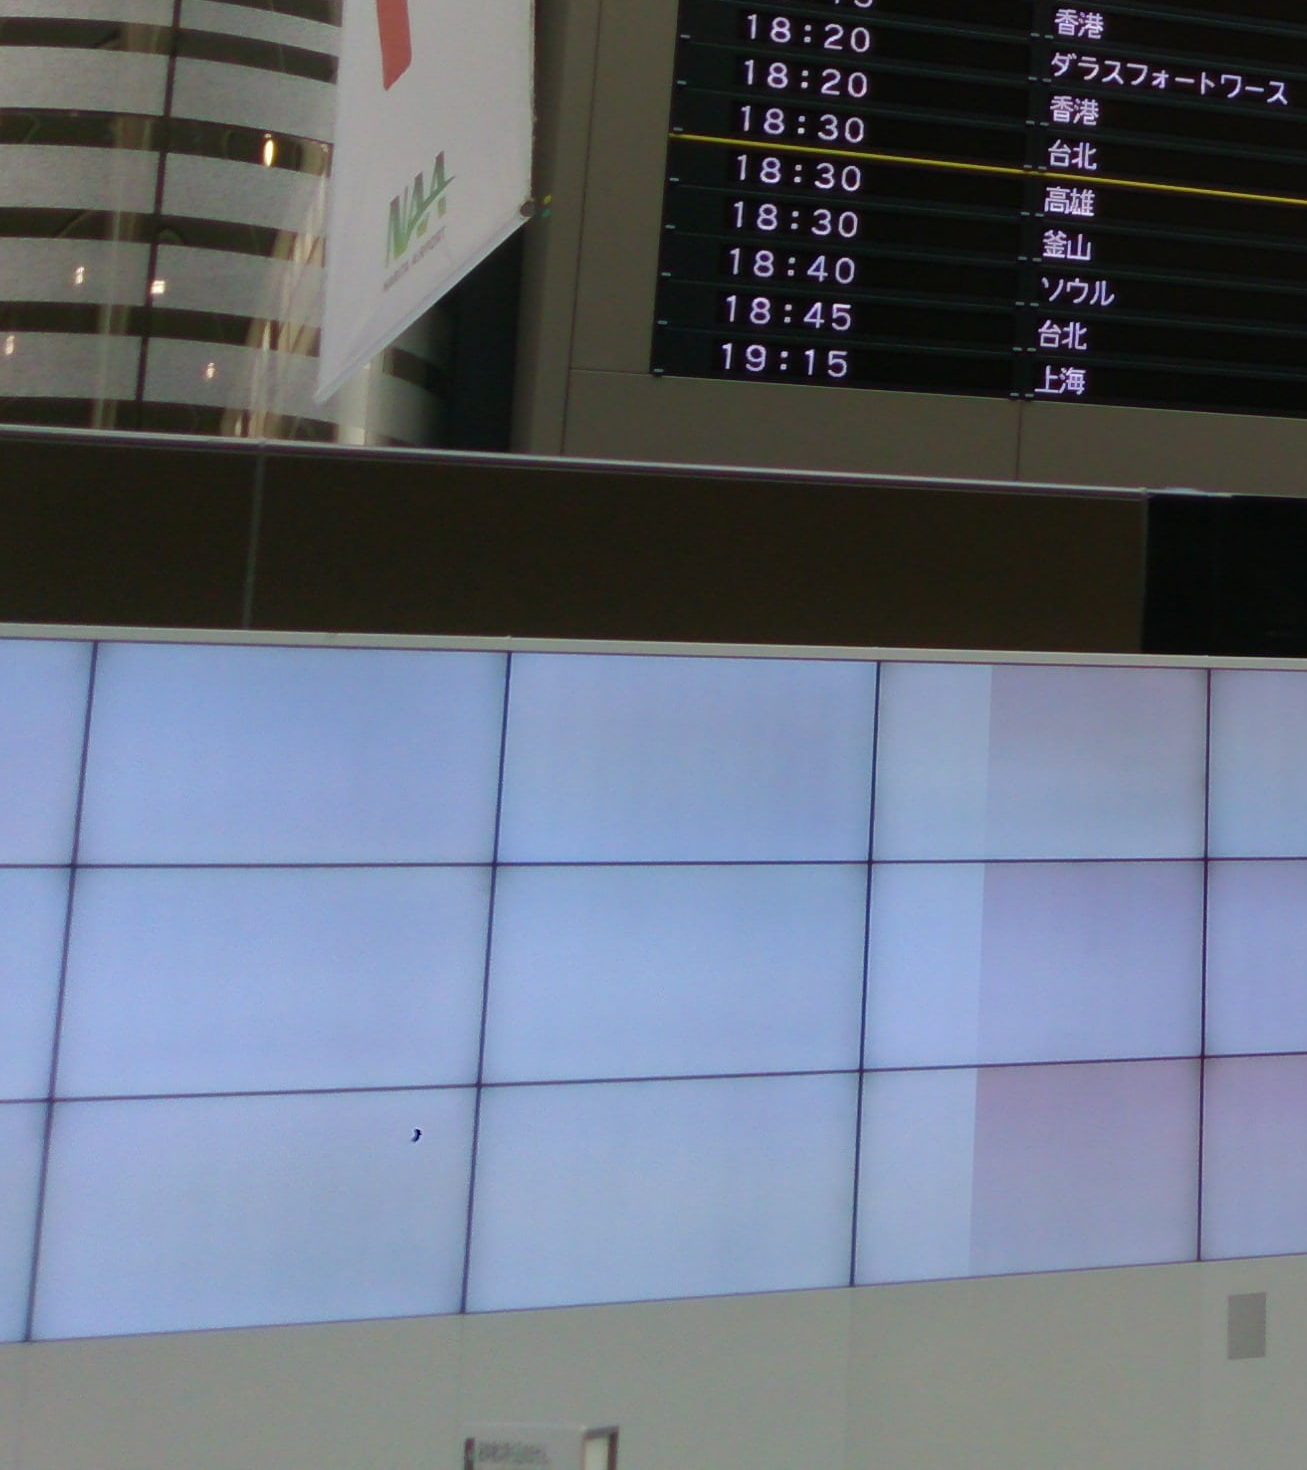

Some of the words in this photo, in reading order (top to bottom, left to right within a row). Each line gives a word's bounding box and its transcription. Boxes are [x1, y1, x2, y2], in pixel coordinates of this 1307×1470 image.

[743, 58, 869, 99] 18:20
[746, 13, 871, 54] 18:20
[1050, 51, 1289, 107] ダラスフォートワース
[740, 104, 866, 145] 18:30
[736, 153, 862, 193] 18:30
[1043, 185, 1097, 219] 高雄
[733, 200, 860, 239] 18:30
[729, 247, 856, 286] 18:40
[724, 293, 853, 332] 18:45
[720, 342, 849, 379] 19:15
[1035, 363, 1088, 396] 上海
